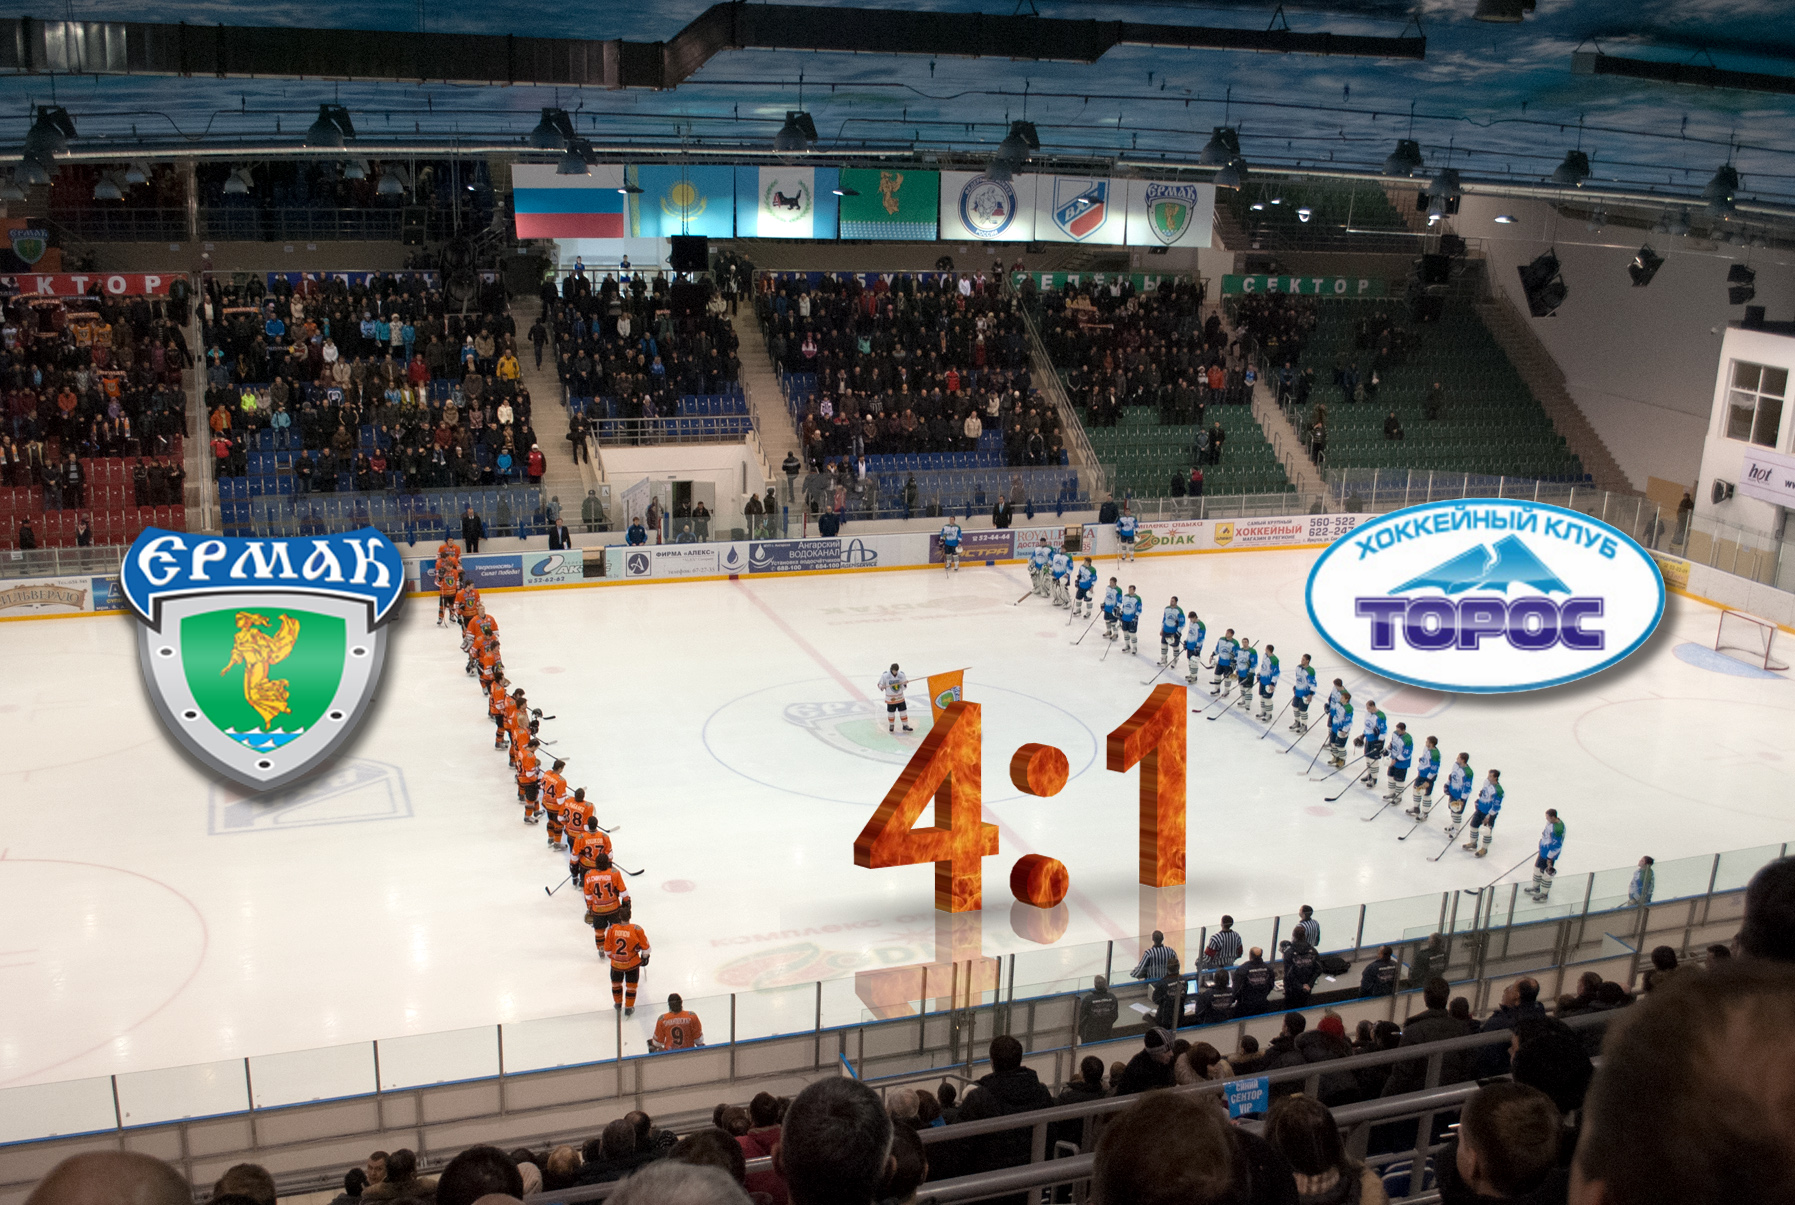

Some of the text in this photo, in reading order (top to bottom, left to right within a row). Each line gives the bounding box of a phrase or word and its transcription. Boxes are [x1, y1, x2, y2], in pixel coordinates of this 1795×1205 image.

[975, 228, 998, 236] РОССИИ
[1242, 277, 1370, 294] СЕКТОР
[1748, 463, 1772, 483] hot
[1310, 517, 1355, 527] 560-522
[1235, 524, 1302, 537] ХОККЕЙНЫЙ
[798, 541, 840, 550] Ангарский
[789, 549, 840, 559] ВОДОКАНАЛ
[593, 882, 615, 899] 41
[615, 938, 628, 956] 2
[670, 1026, 684, 1046] 9
[1231, 1089, 1263, 1104] СЕКТОР
[1239, 1103, 1252, 1114] VIP
